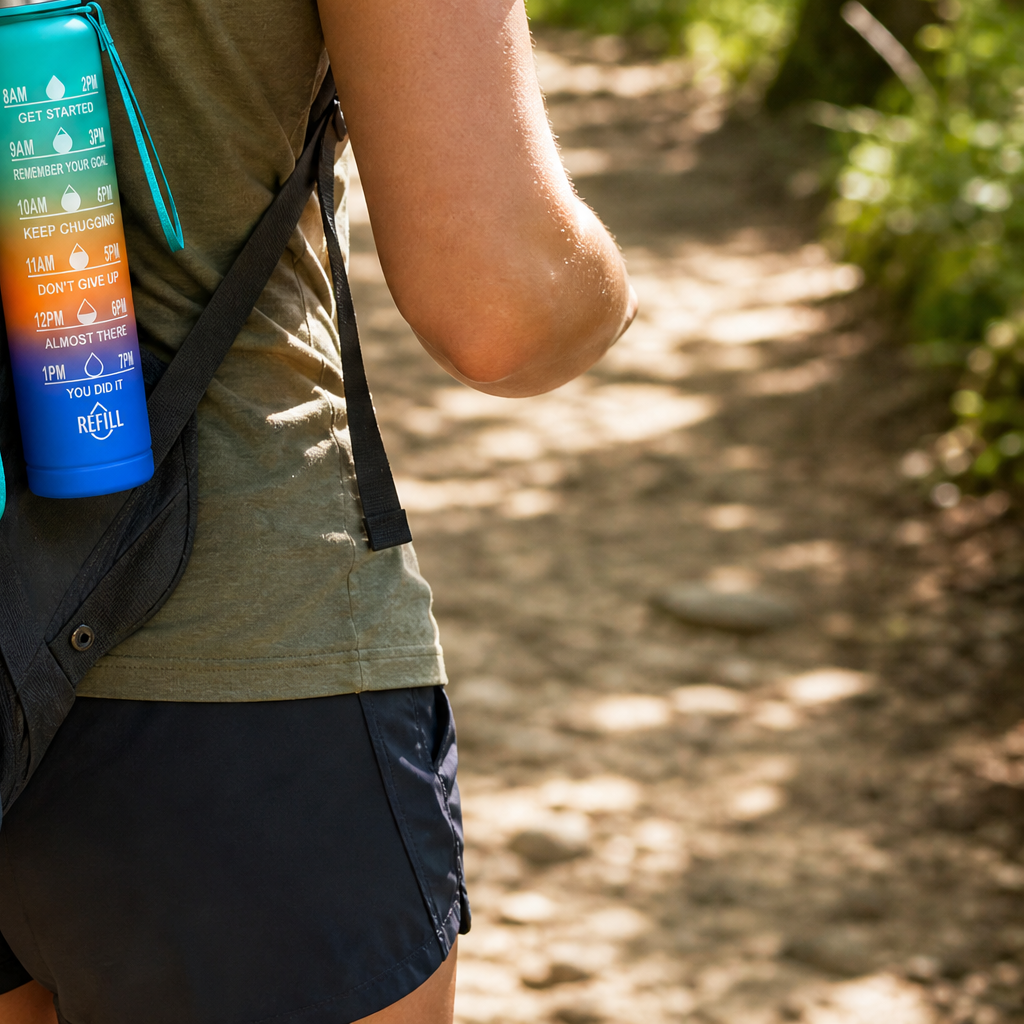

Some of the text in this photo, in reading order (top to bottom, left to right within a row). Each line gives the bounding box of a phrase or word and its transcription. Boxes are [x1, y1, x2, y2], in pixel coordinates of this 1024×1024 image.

[2, 74, 98, 104] 8AM 2PM
[18, 102, 94, 124] GET STARTED
[9, 127, 105, 158] 9AM 3PM
[13, 163, 63, 181] REMEMBER
[65, 159, 90, 173] YOUR
[17, 196, 48, 216] 10AM
[23, 213, 115, 240] KEEP CHUGGING
[26, 242, 120, 274] 11AM 5PM
[38, 271, 119, 296] DON'T GIVE UP
[34, 297, 127, 328] 12PM 6PM
[45, 324, 128, 350] ALMOST THERE
[42, 350, 134, 382] 1PM 7PM
[66, 379, 123, 399] YOU DID IT
[77, 410, 124, 434] REFILL
